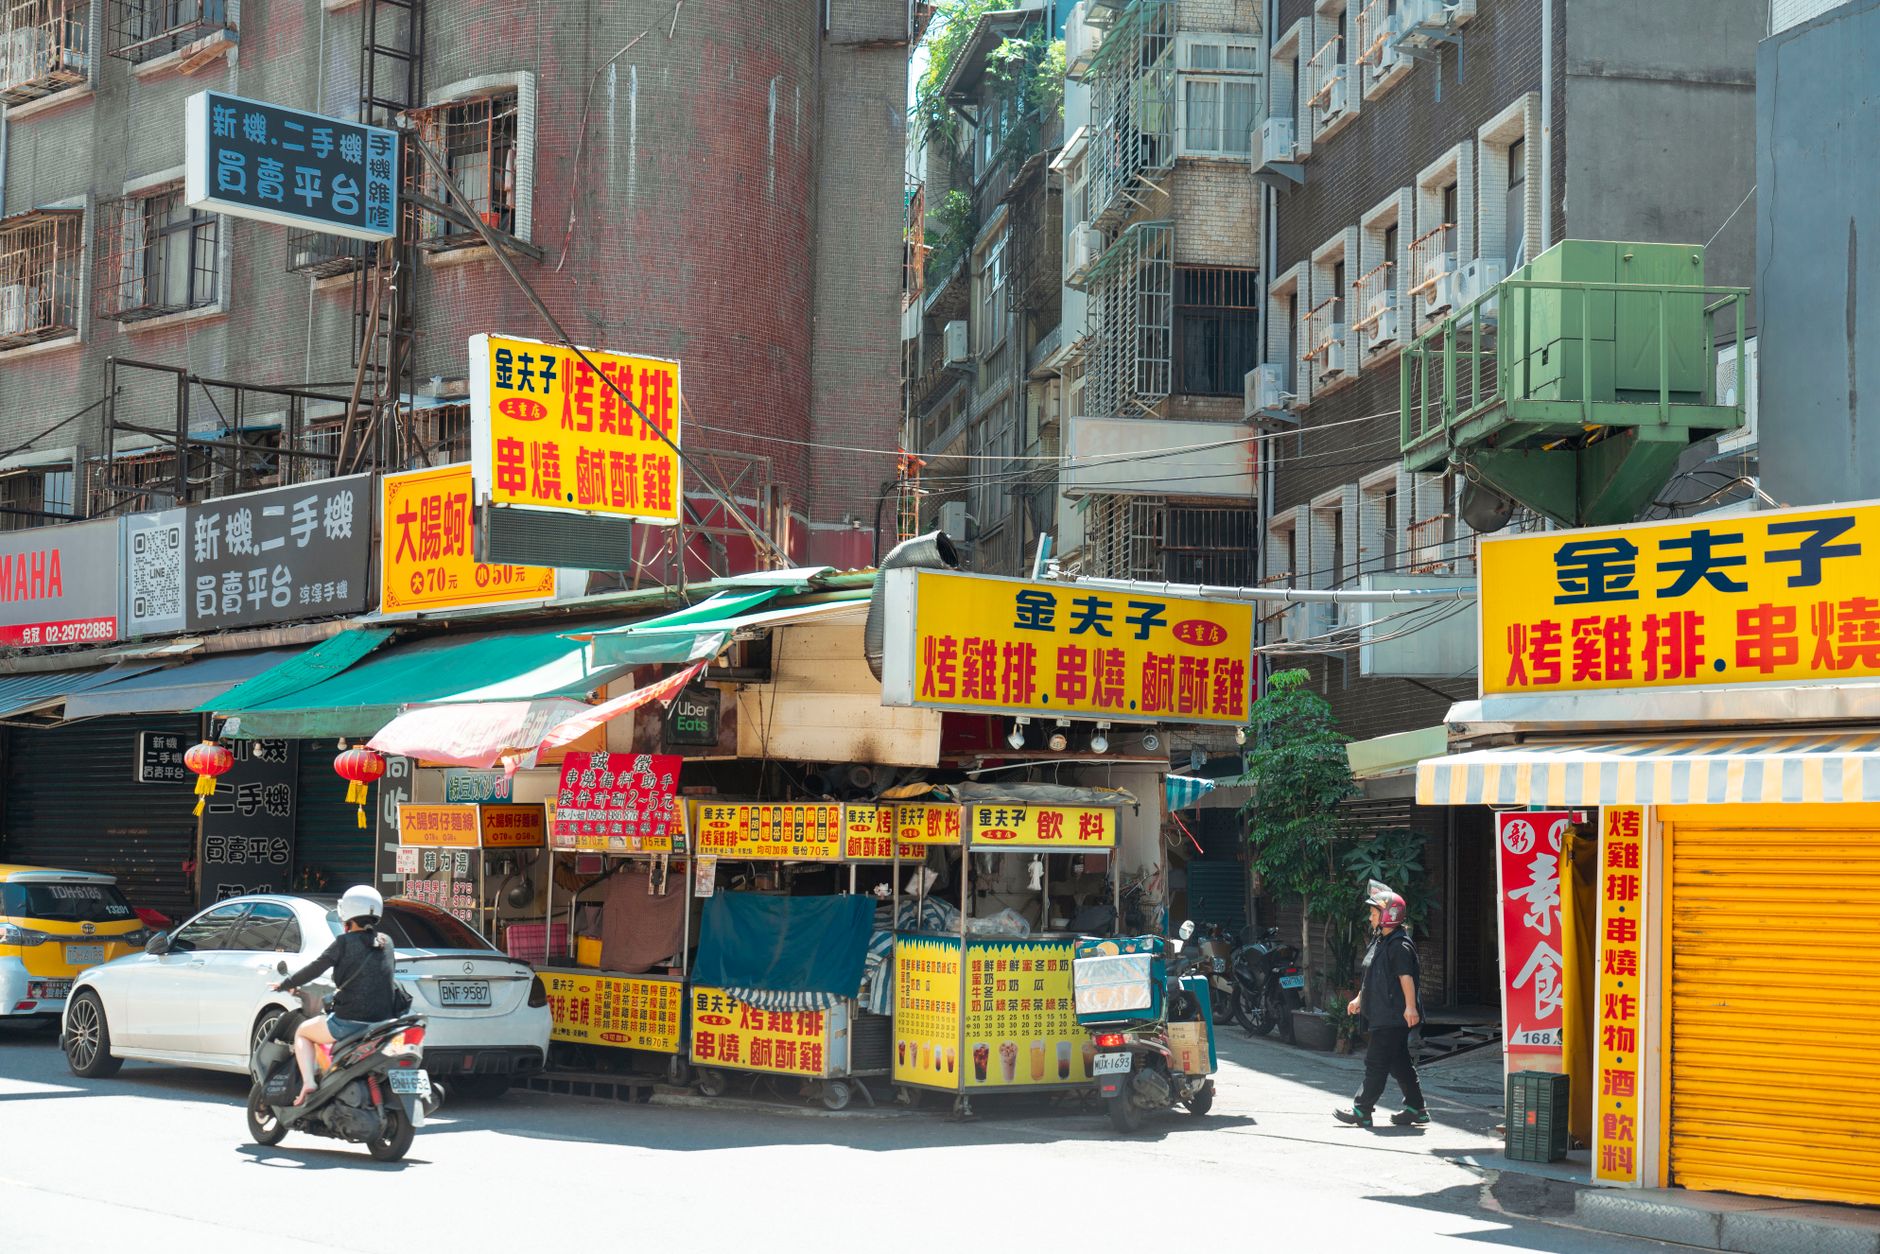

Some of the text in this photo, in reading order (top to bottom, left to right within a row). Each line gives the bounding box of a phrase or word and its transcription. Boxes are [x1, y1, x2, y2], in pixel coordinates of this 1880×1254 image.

[217, 148, 361, 216] 買賣平台
[368, 134, 392, 227] 手機維修
[496, 348, 557, 394] 金夫子
[506, 401, 542, 419] 三重店
[561, 357, 673, 442] 烤雞排
[396, 492, 474, 564] 大腸蚵
[1552, 515, 1862, 606] 金夫子
[149, 567, 165, 579] LINE
[196, 564, 292, 619] 買賣平台
[1013, 588, 1220, 643] 金夫子 三重店
[678, 701, 709, 717] Uber
[677, 716, 708, 731] Eats
[152, 736, 178, 749] 新機
[147, 751, 183, 764] 二手機
[208, 782, 291, 817] 二手機
[703, 807, 737, 821] 金夫子
[848, 809, 876, 824] 金夫子
[899, 807, 961, 838] 金夫子 飲料
[979, 808, 1105, 841] 金夫子 飲料
[700, 829, 739, 847] 烤雞排
[205, 836, 290, 864] 買賣平台
[423, 851, 470, 874] 精力湯
[105, 904, 129, 915] 13201
[441, 985, 488, 1001] BNF-9587
[983, 959, 994, 1012] 鮮奶冬瓜
[696, 993, 738, 1014] 金夫子
[1522, 1032, 1550, 1045] 168
